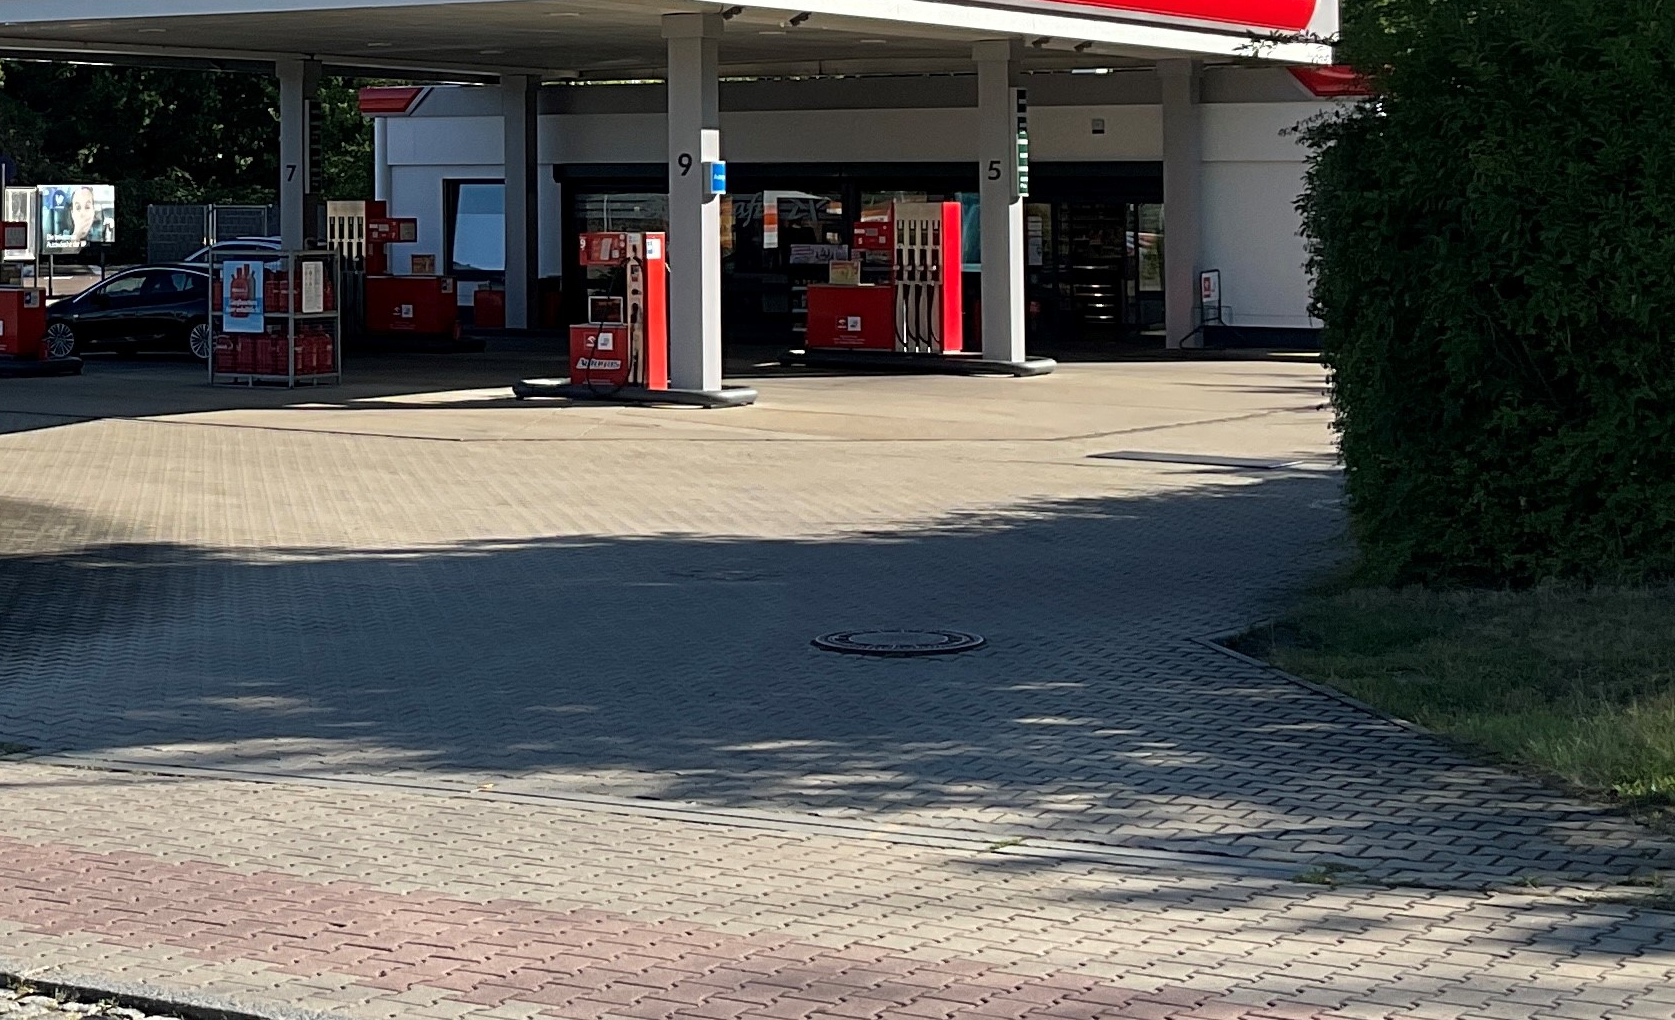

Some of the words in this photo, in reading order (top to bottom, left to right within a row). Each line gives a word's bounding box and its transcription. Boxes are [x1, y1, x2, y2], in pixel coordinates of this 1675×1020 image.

[286, 164, 298, 182] 7
[678, 153, 693, 177] 9
[987, 160, 1002, 181] 5
